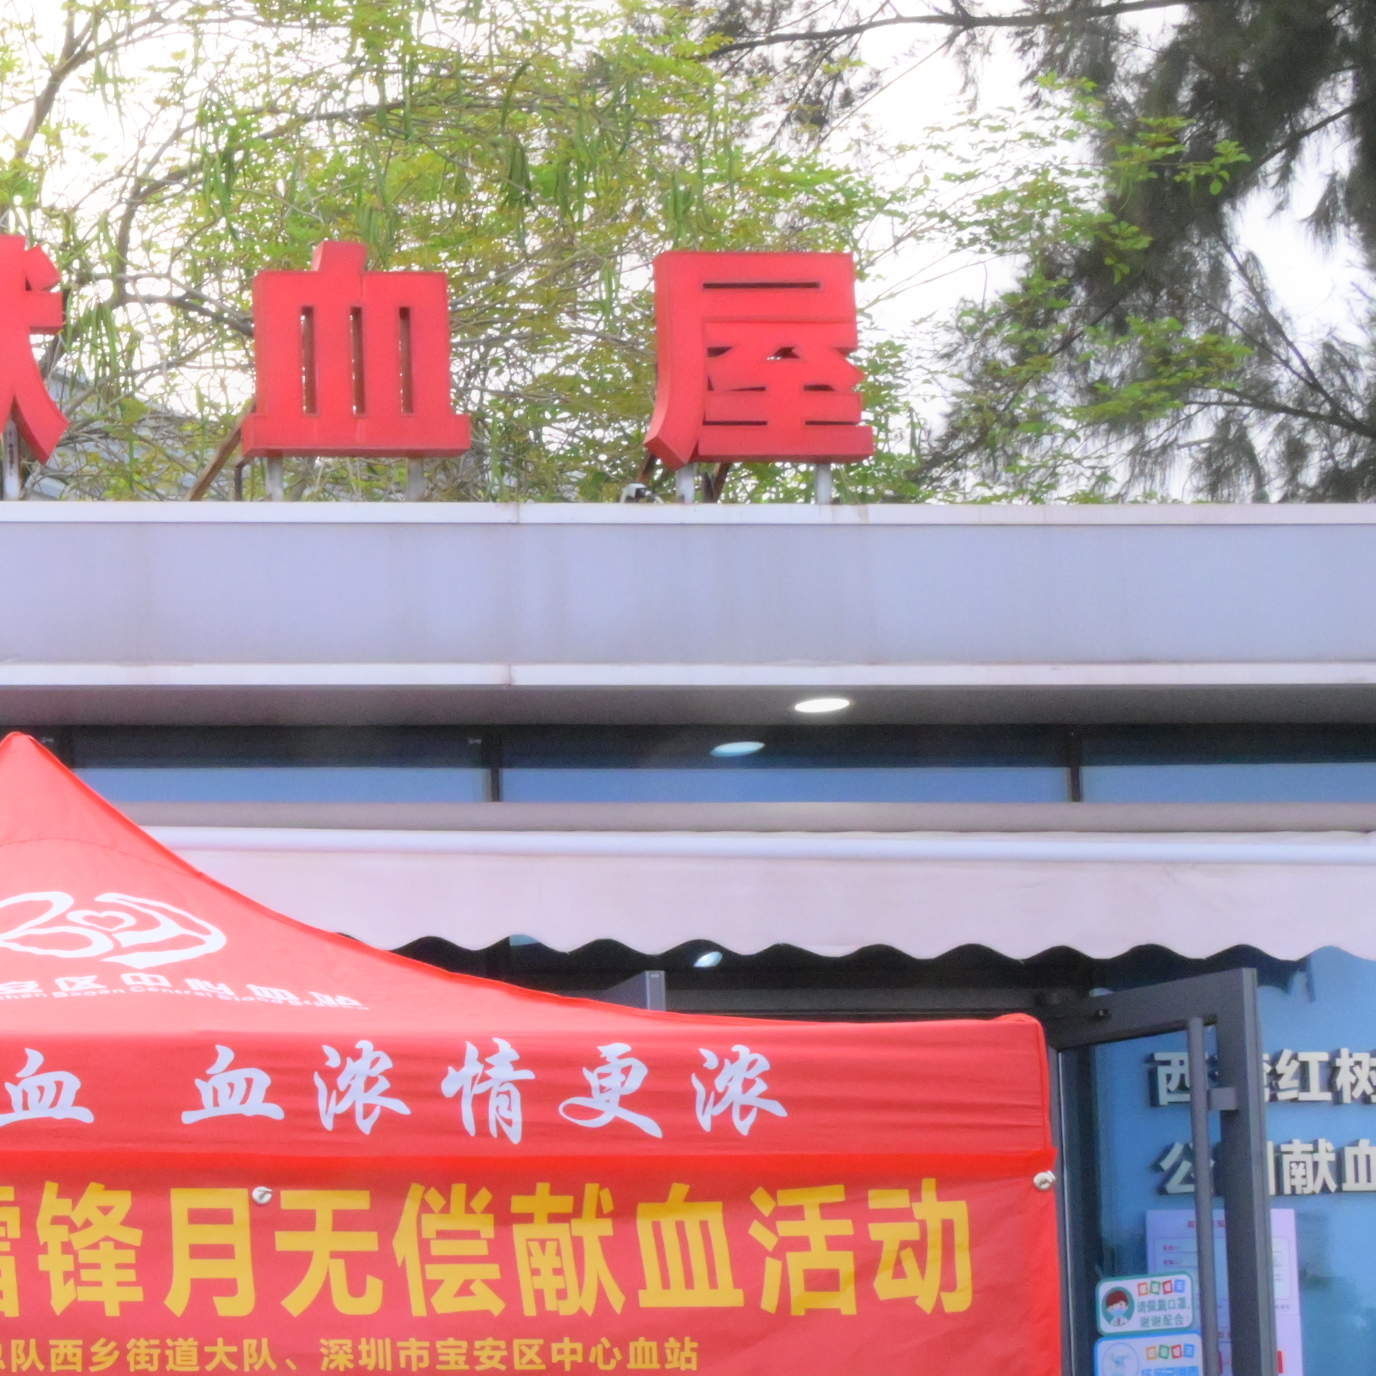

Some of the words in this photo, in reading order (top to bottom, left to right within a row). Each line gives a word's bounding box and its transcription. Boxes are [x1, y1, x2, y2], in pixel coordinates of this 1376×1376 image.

[180, 1037, 788, 1145] 血浓情更浓
